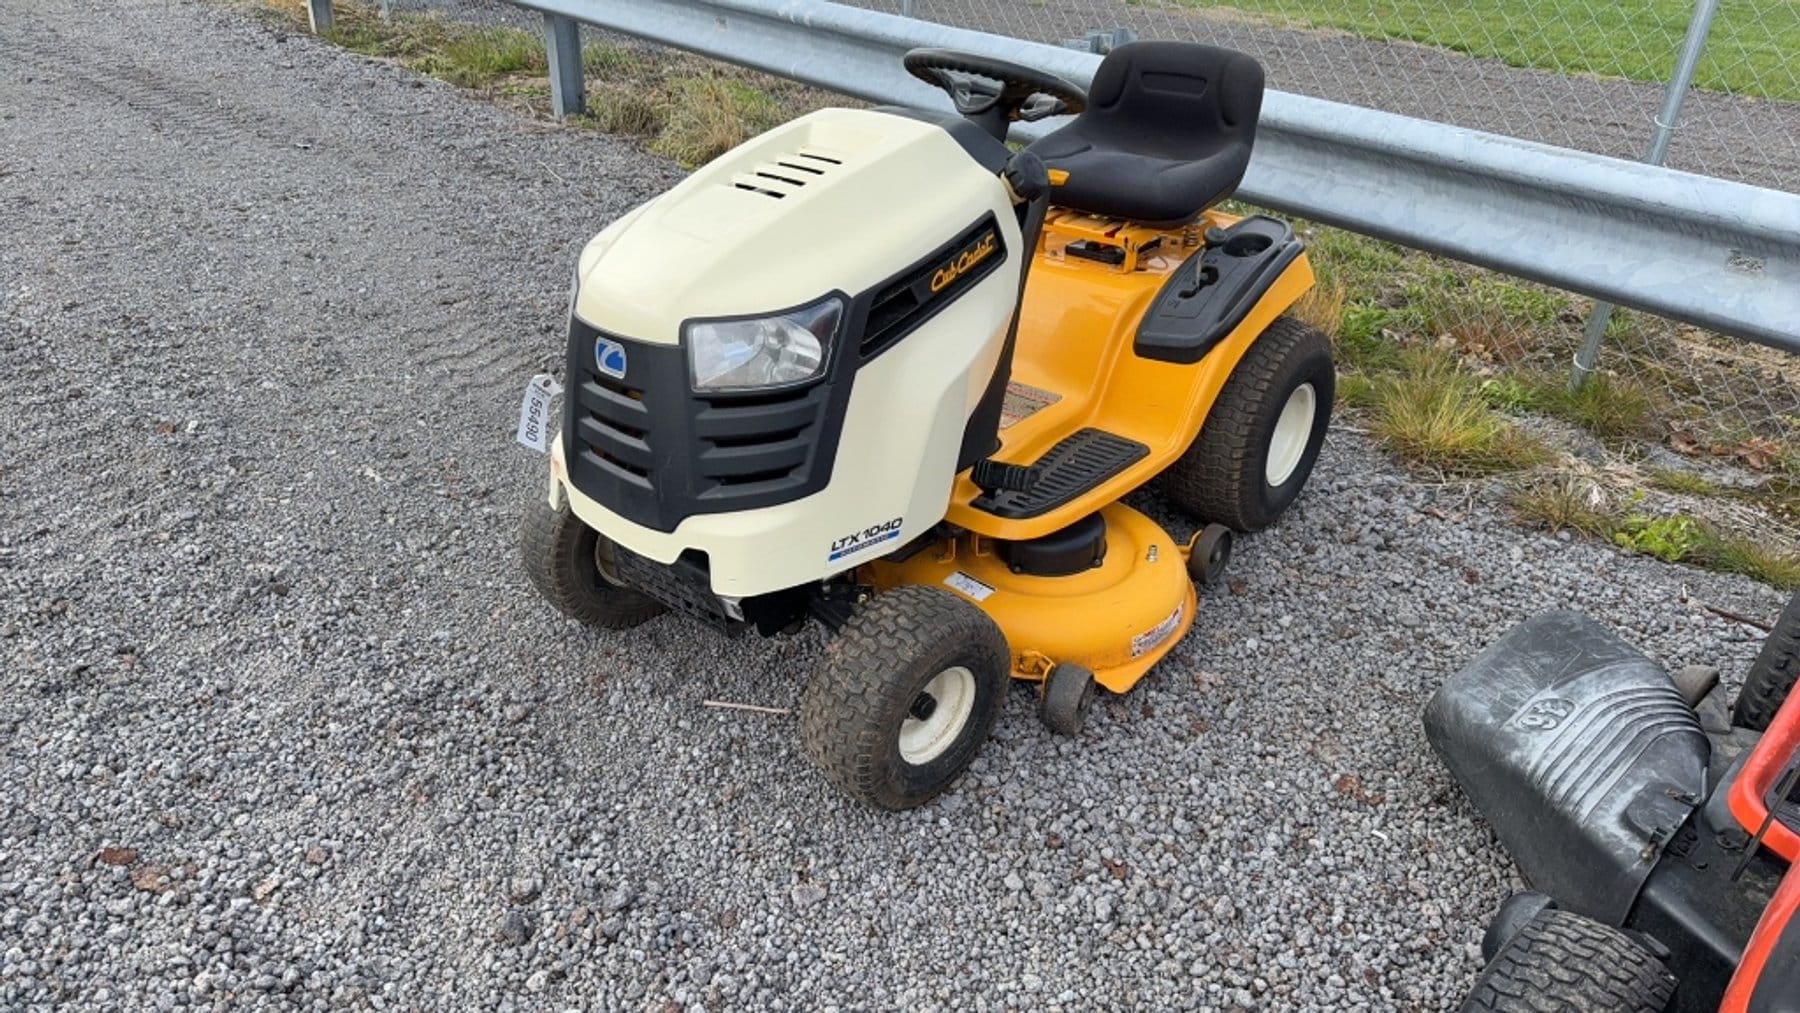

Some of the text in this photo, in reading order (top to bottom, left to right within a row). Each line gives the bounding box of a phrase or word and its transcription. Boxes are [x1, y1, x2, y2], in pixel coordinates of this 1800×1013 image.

[931, 233, 994, 292] Cub Cadet
[526, 397, 543, 442] 55490
[831, 532, 860, 551] LTX
[863, 517, 902, 539] 1040
